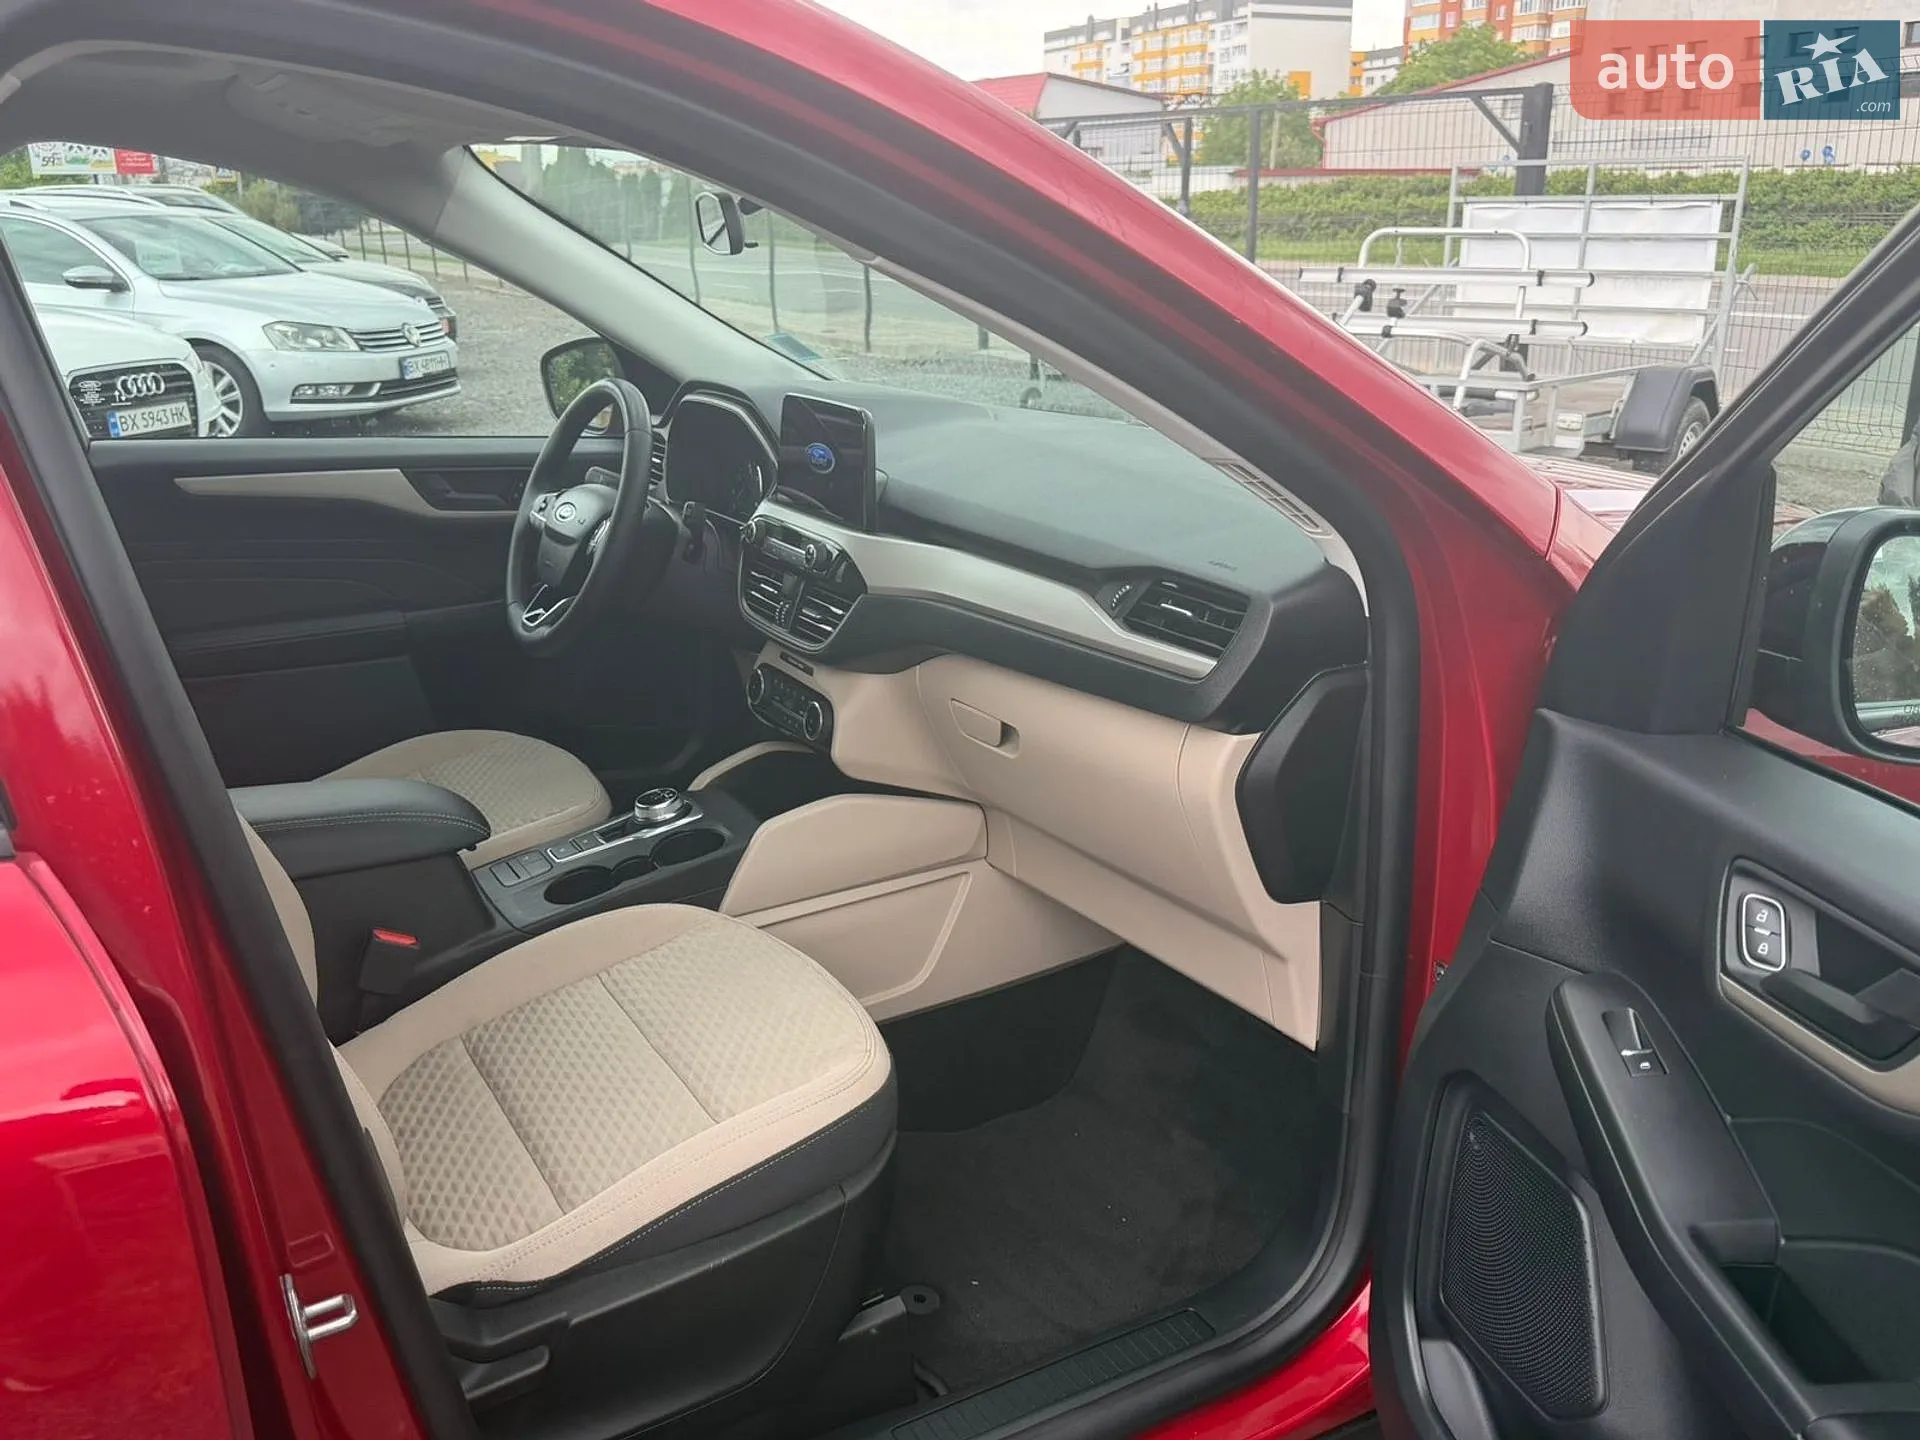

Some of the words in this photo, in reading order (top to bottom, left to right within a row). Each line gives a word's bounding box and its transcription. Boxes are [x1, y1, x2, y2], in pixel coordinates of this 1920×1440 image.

[119, 413, 140, 432] BX
[141, 409, 169, 429] 5943
[170, 405, 188, 424] HK
